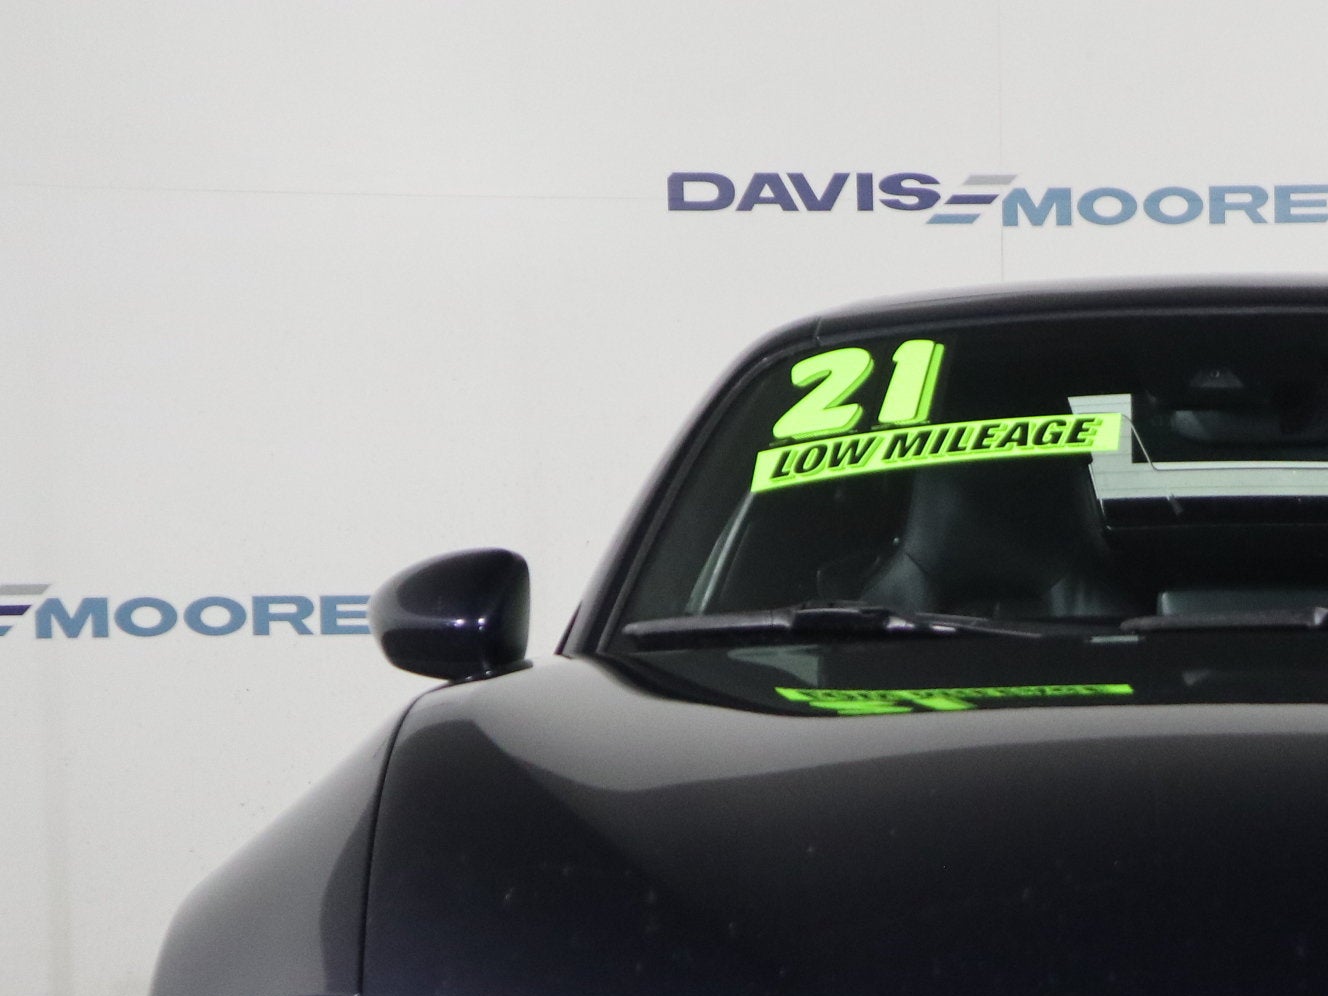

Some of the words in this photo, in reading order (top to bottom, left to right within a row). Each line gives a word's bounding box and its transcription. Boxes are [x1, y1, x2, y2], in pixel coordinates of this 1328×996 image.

[667, 172, 941, 211] DAVIS
[772, 339, 945, 441] 21
[769, 436, 880, 482] LOW
[881, 416, 1102, 464] MILEAGE
[35, 595, 370, 639] MOORE
